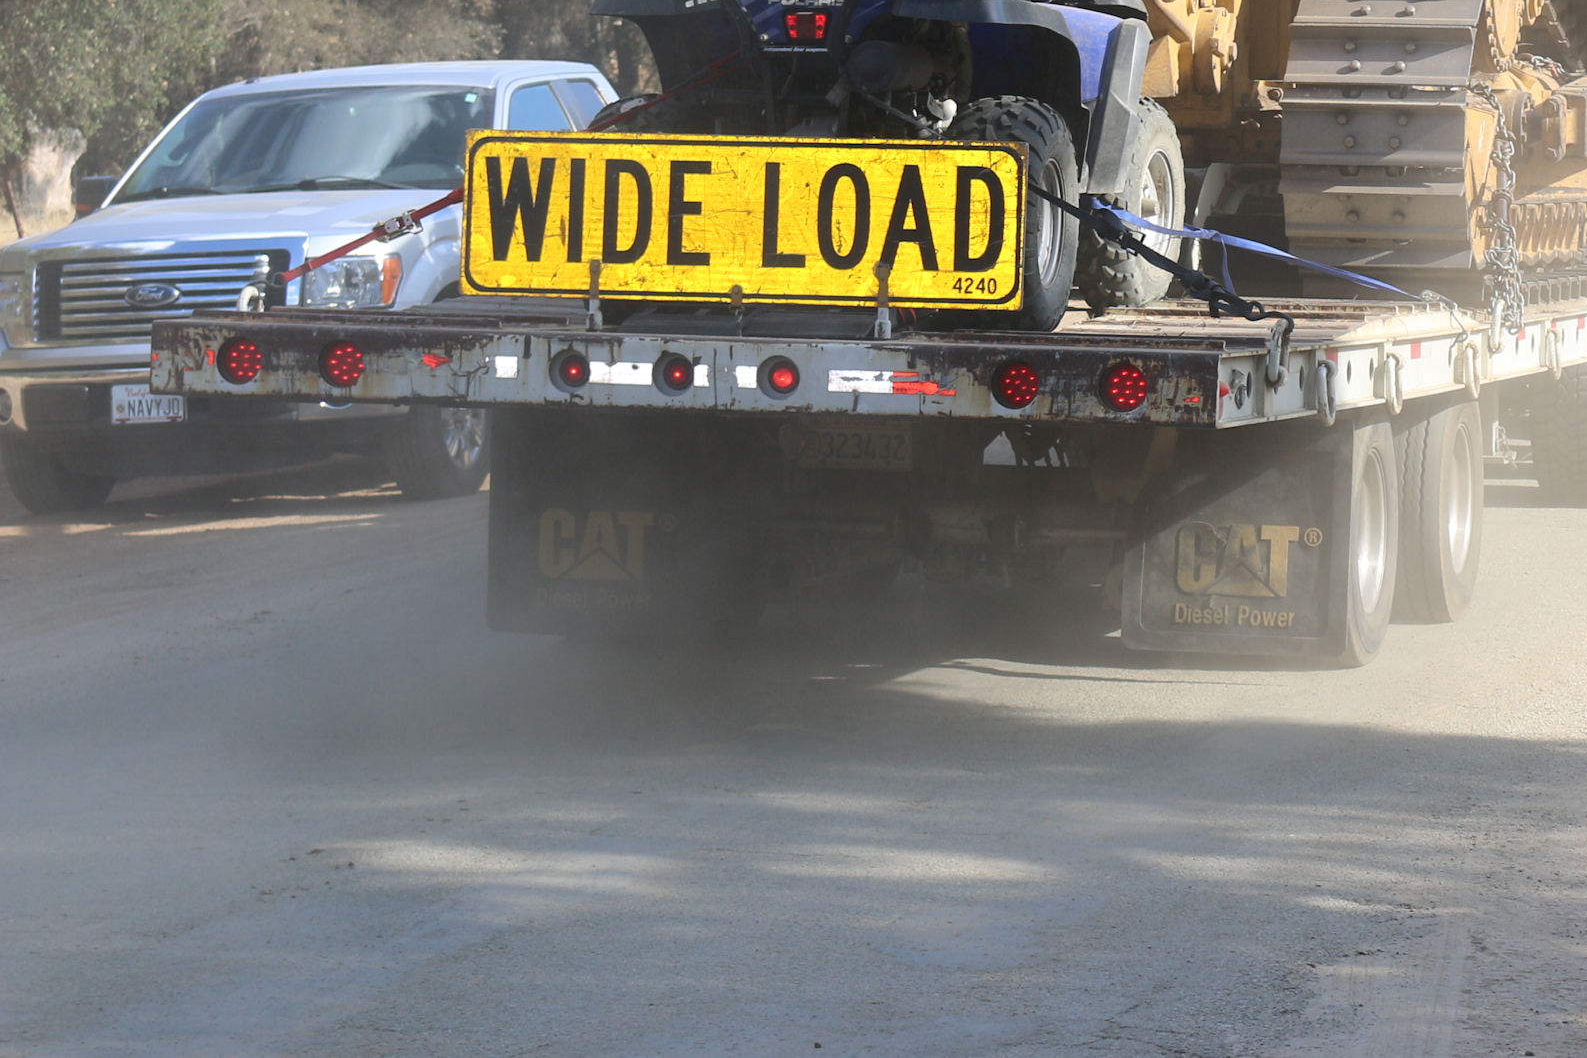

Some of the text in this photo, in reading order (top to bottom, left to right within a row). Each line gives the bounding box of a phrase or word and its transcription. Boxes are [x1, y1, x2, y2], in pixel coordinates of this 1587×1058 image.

[486, 155, 1006, 273] WIDE LOAD
[136, 286, 165, 302] Ford
[952, 276, 998, 296] 4240
[536, 587, 588, 610] Diesel
[1173, 602, 1296, 628] Diesel Power
